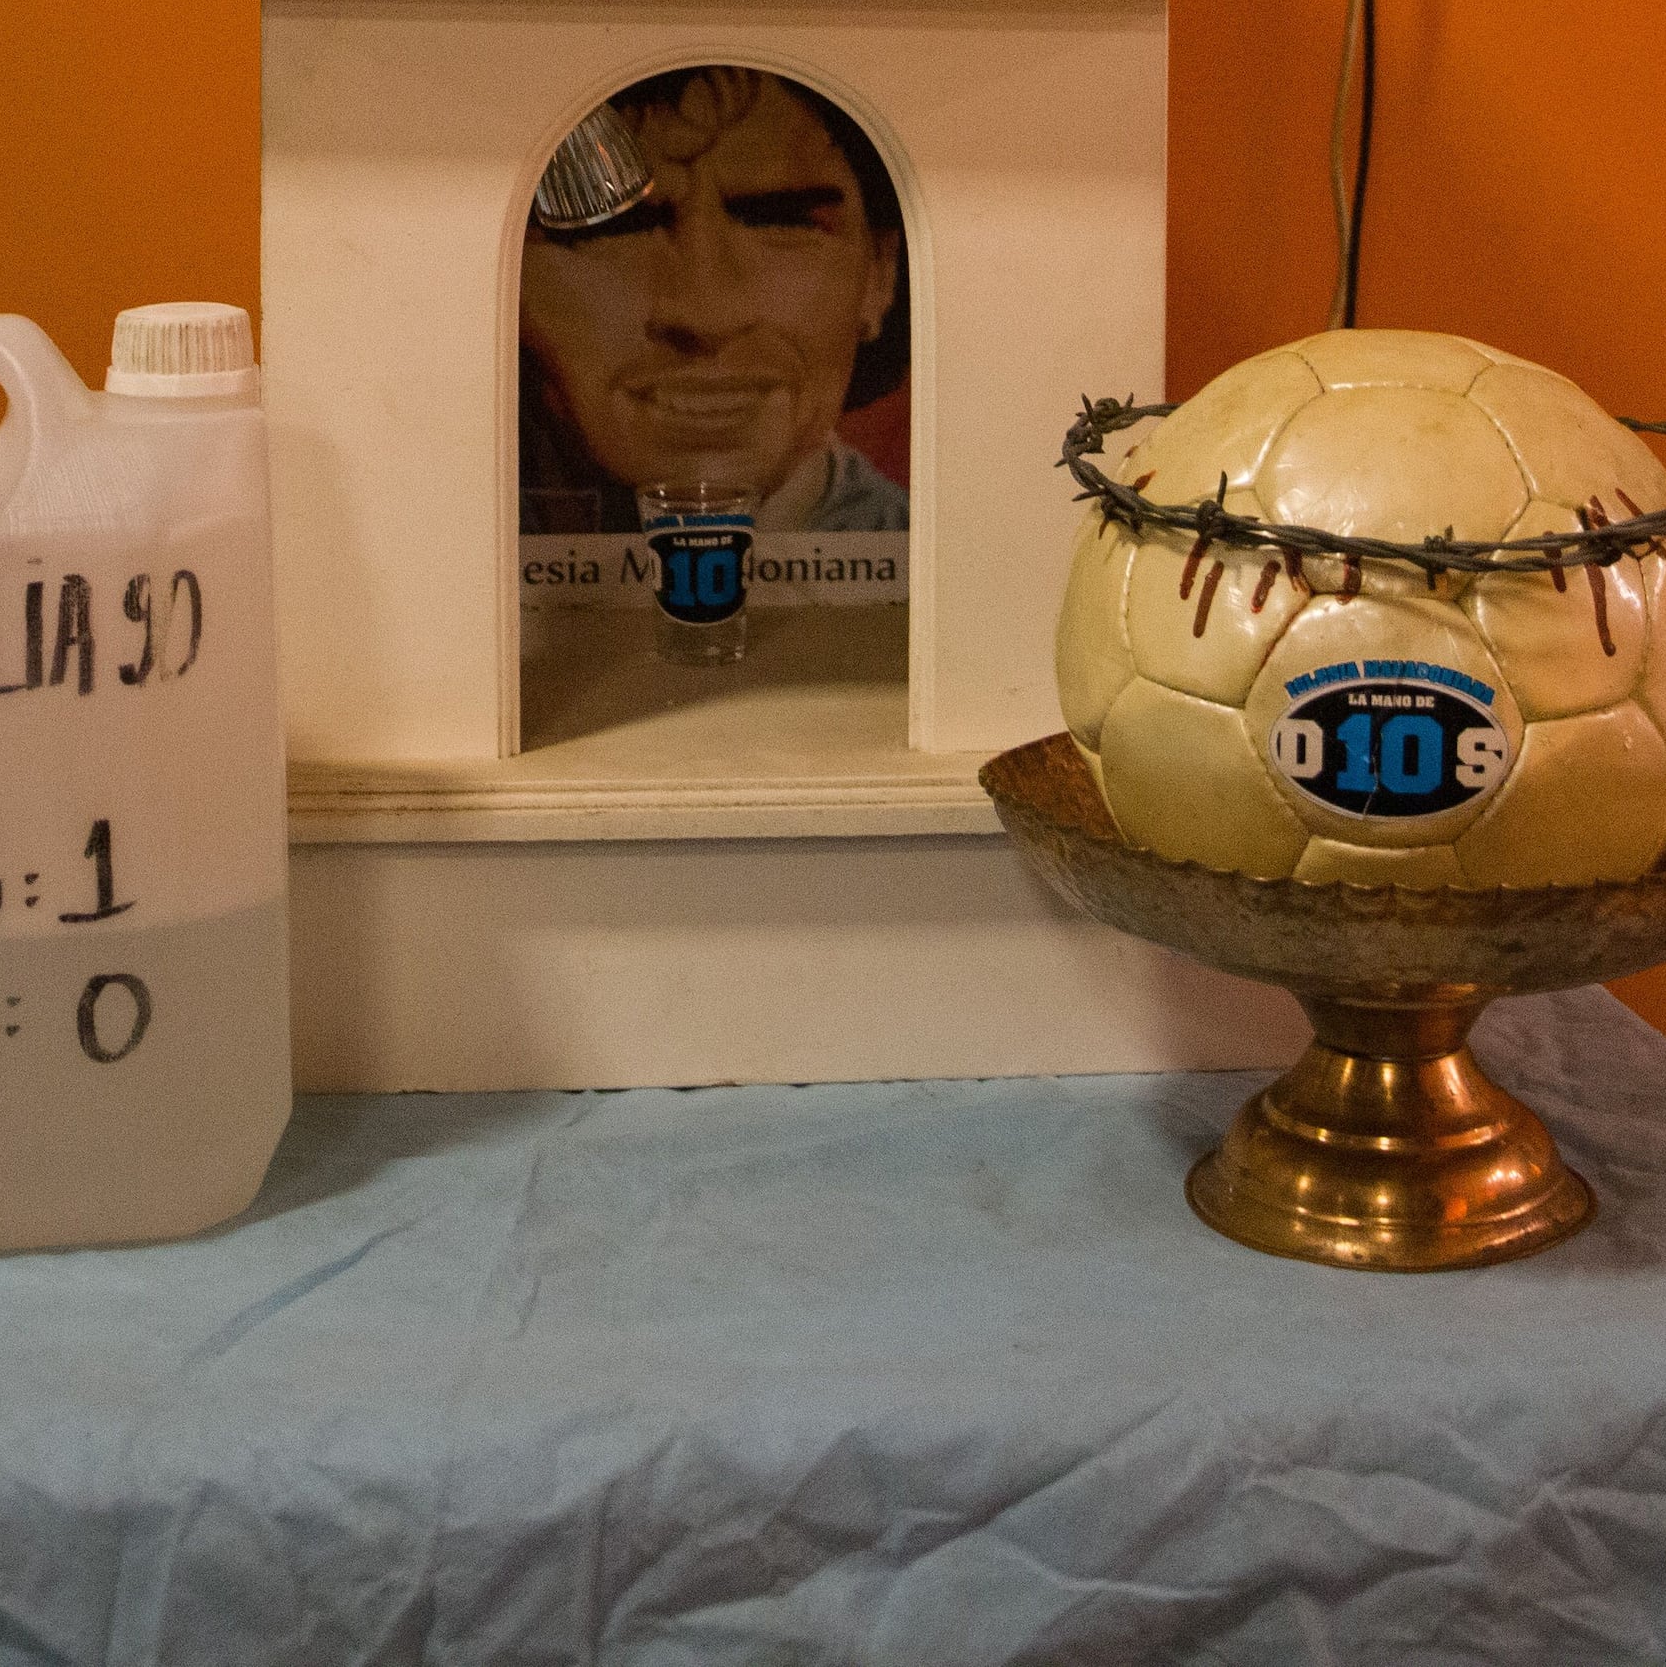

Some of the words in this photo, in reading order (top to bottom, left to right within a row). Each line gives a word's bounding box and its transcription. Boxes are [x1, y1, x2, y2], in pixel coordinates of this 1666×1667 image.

[667, 548, 739, 608] 10
[119, 569, 203, 687] 90
[1348, 693, 1367, 706] LA
[1371, 694, 1412, 708] MANO
[1416, 695, 1435, 708] DE
